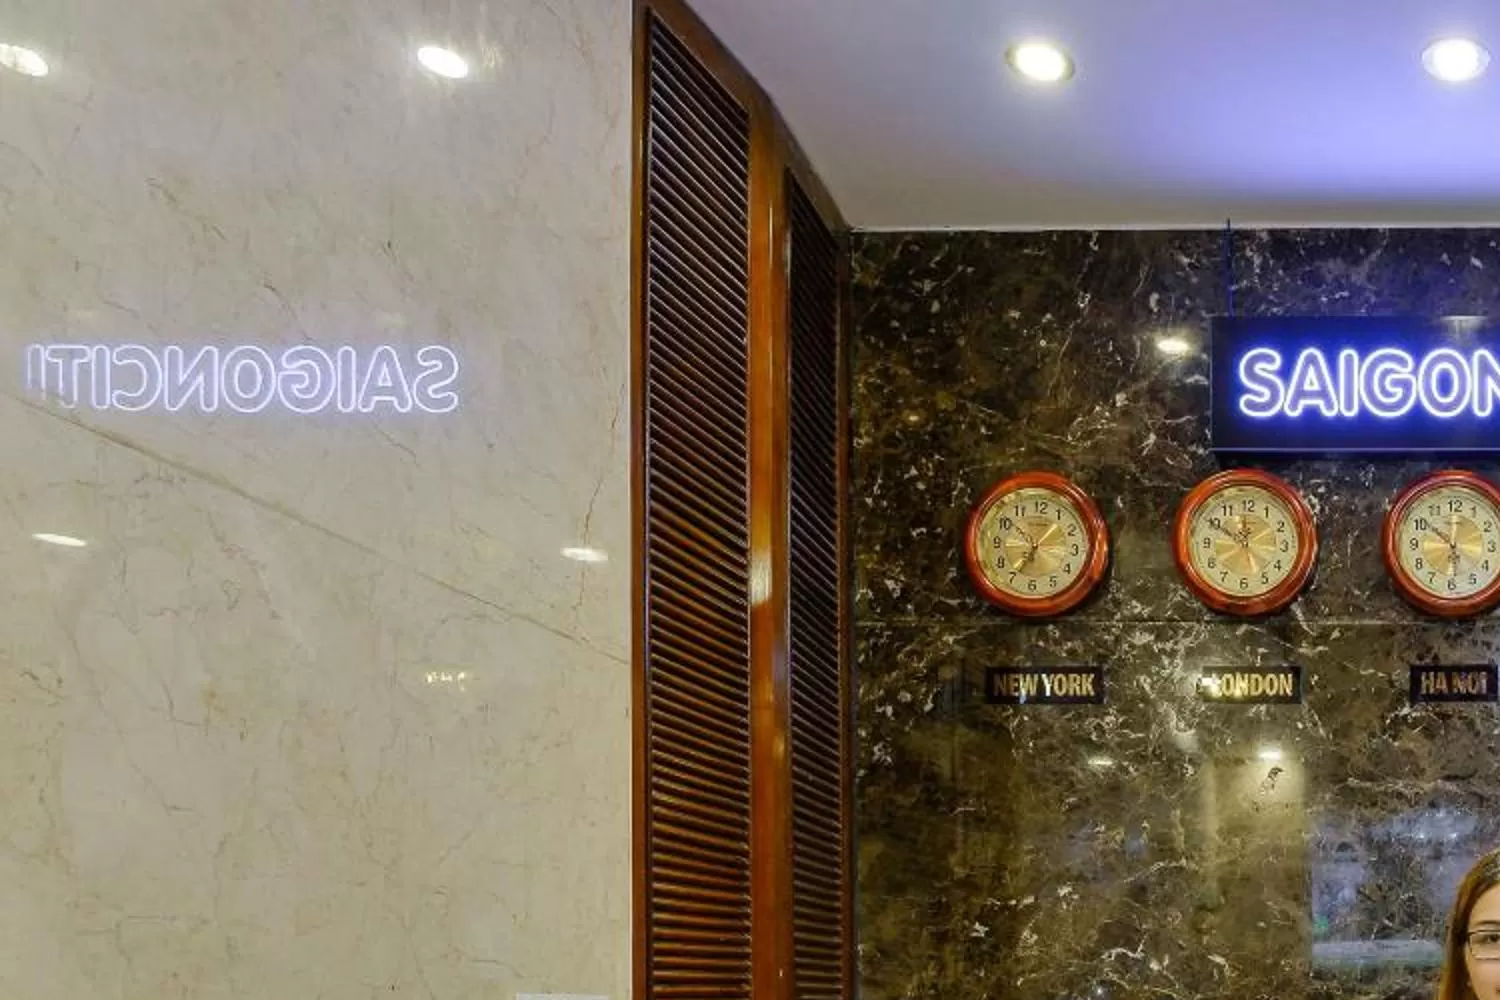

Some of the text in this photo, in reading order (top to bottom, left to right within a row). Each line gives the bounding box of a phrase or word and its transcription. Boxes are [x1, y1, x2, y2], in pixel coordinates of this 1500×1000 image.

[1014, 504, 1026, 517] 11
[1034, 501, 1049, 515] 12
[1222, 504, 1233, 517] 11
[1242, 500, 1255, 513] 12
[1264, 506, 1269, 518] 1
[1428, 504, 1441, 516] 11
[1448, 500, 1463, 513] 12
[1469, 506, 1477, 518] 1
[1055, 509, 1061, 521] 1
[999, 517, 1013, 531] 10
[1067, 524, 1077, 537] 2
[1277, 520, 1285, 533] 2
[1414, 519, 1427, 531] 10
[1483, 520, 1492, 533] 2
[993, 536, 1001, 549] 9
[1203, 537, 1211, 549] 9
[1279, 540, 1288, 552] 3
[1409, 537, 1419, 550] 9
[1487, 540, 1496, 553] 3
[1071, 543, 1079, 556] 3
[996, 556, 1005, 569] 8
[1062, 563, 1071, 575] 4
[1273, 559, 1282, 571] 4
[1415, 558, 1424, 570] 8
[1481, 560, 1489, 572] 4
[1009, 571, 1017, 584] 7
[1049, 575, 1058, 588] 5
[1220, 570, 1229, 583] 7
[1261, 572, 1269, 585] 5
[1427, 571, 1436, 584] 7
[1468, 573, 1477, 585] 5
[1028, 580, 1037, 591] 6
[1239, 577, 1249, 590] 6
[1447, 579, 1457, 590] 6
[993, 673, 1096, 697] NEW YORK
[1421, 671, 1448, 695] HA
